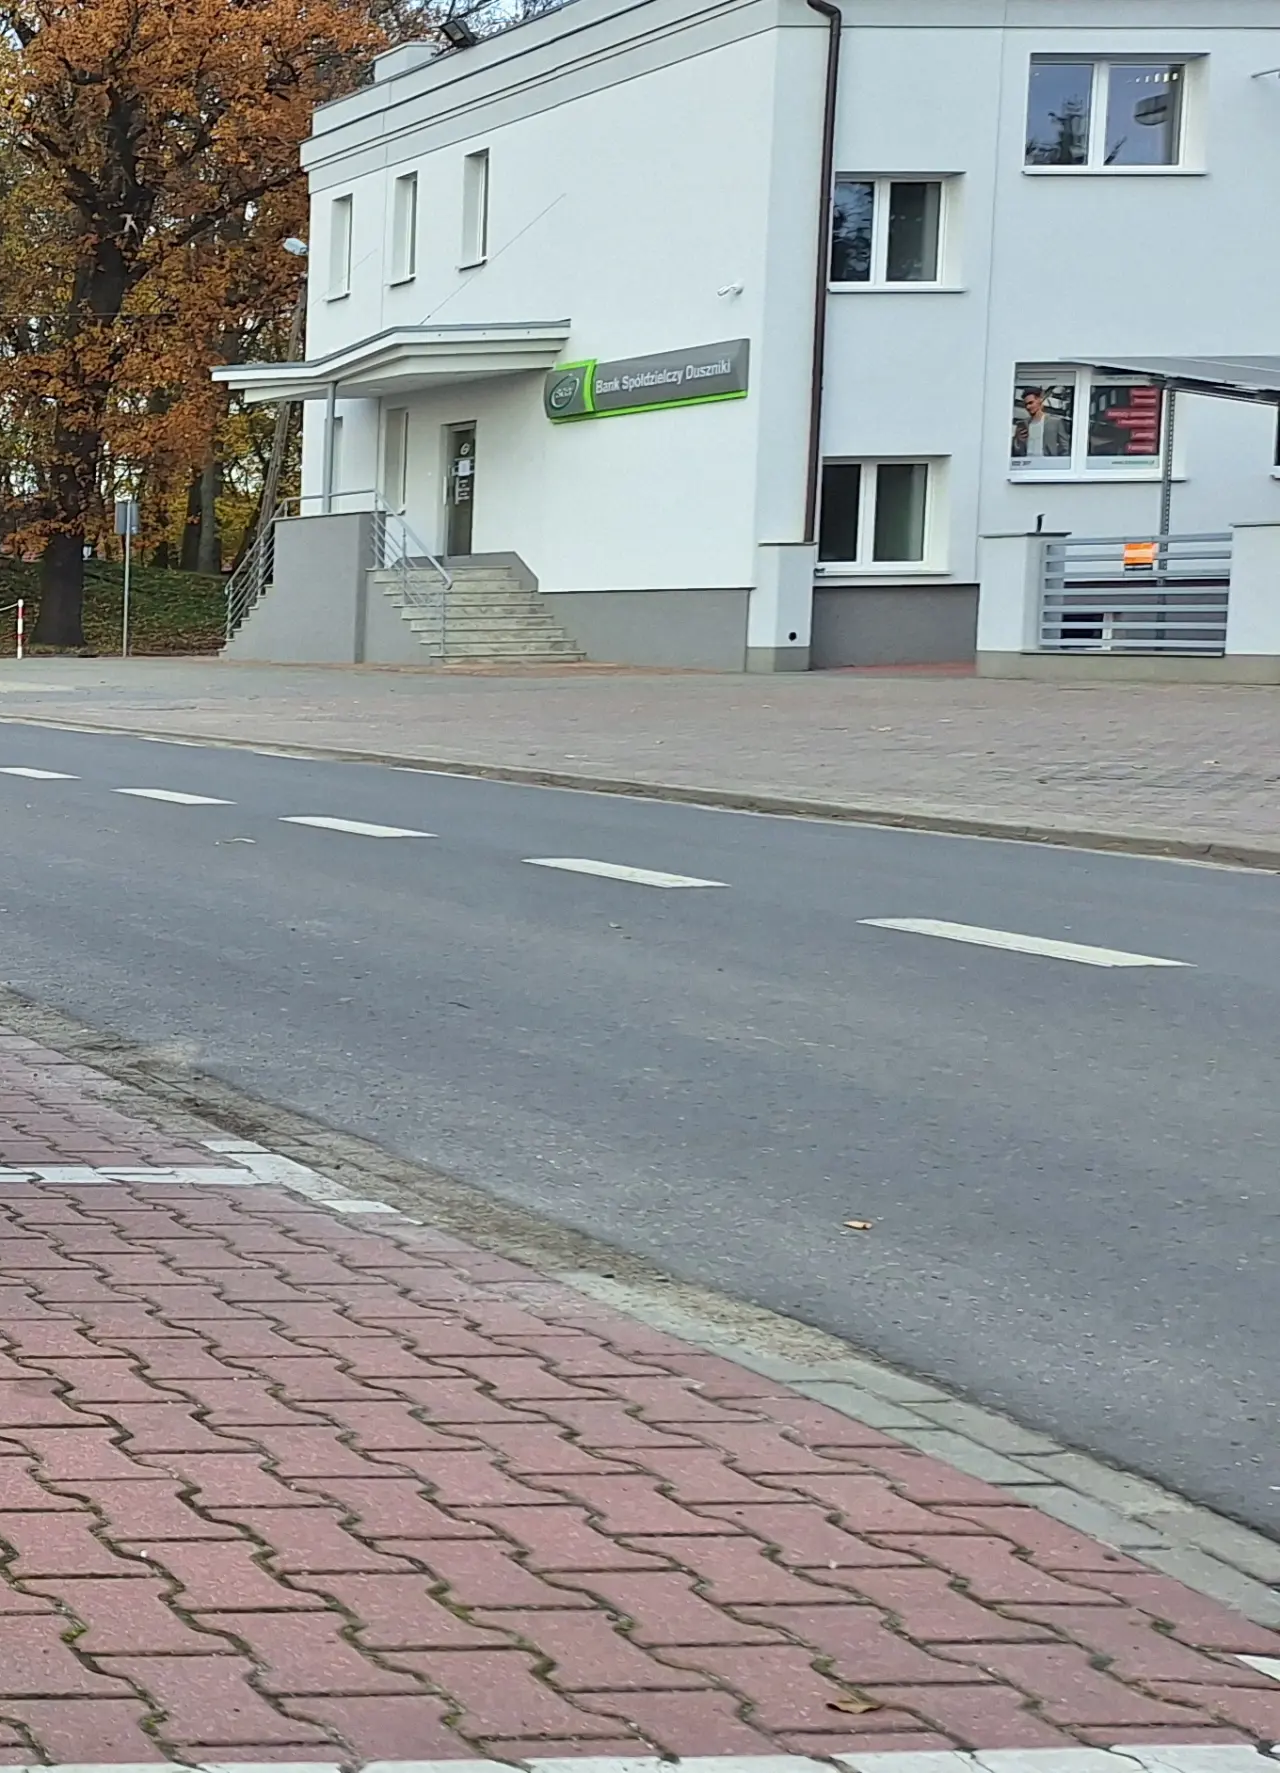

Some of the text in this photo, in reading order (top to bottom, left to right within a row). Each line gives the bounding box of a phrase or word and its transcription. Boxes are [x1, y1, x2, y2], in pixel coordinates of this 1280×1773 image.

[595, 379, 620, 394] Bank
[621, 368, 685, 392] Spółdzielczy
[685, 360, 731, 379] Duszniki
